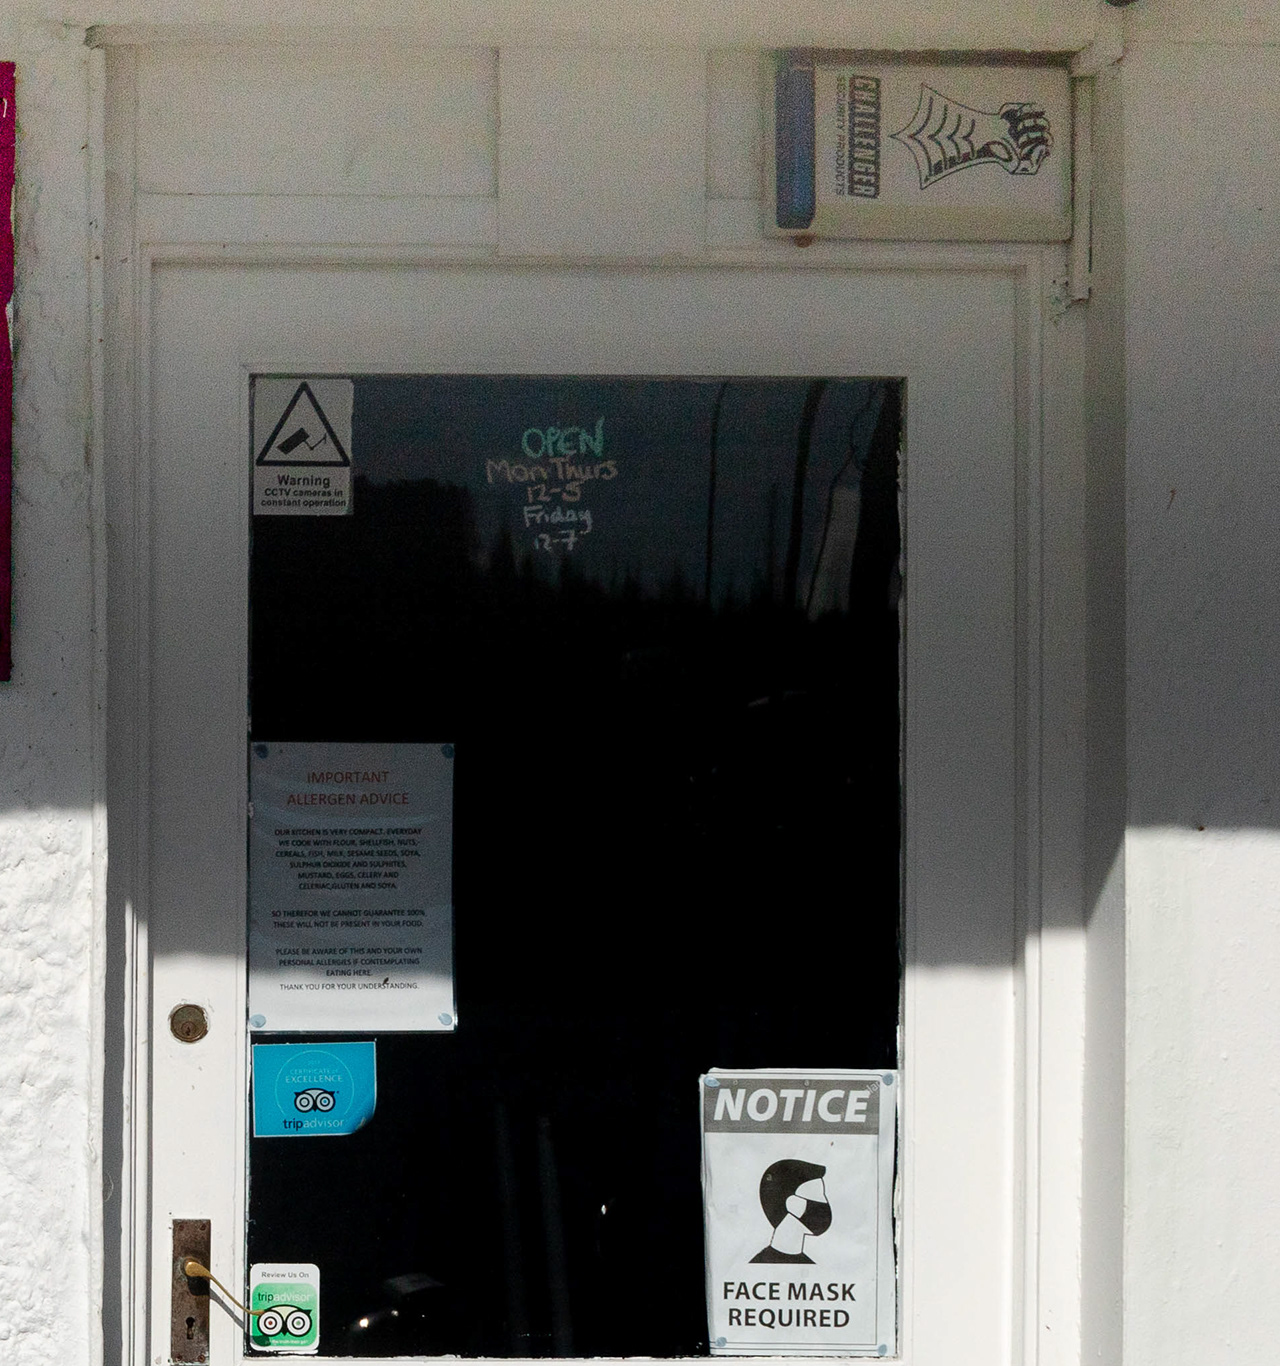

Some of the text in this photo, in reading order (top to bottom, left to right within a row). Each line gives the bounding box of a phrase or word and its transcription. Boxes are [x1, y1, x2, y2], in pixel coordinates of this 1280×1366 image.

[835, 76, 846, 196] SECURITY PRODUCTS
[852, 77, 876, 196] CHALLENGER
[522, 416, 605, 458] OPEN
[485, 456, 619, 484] Mon Thurs
[277, 474, 330, 488] Warning
[264, 488, 343, 497] CCTV cameras in
[527, 481, 585, 503] 12-5
[261, 499, 346, 508] constant operation
[523, 505, 593, 536] Friday
[534, 529, 578, 551] 12-7
[307, 771, 389, 784] IMPORTANT
[287, 793, 409, 806] ALLERGEN ADVICE
[285, 1075, 343, 1083] EXCELLENCE
[713, 1088, 871, 1123] NOTICE
[283, 1118, 345, 1131] tripadvisor
[257, 1291, 311, 1303] tripadvisor
[723, 1281, 857, 1301] FACE MASK
[728, 1308, 851, 1329] REQUIRED
